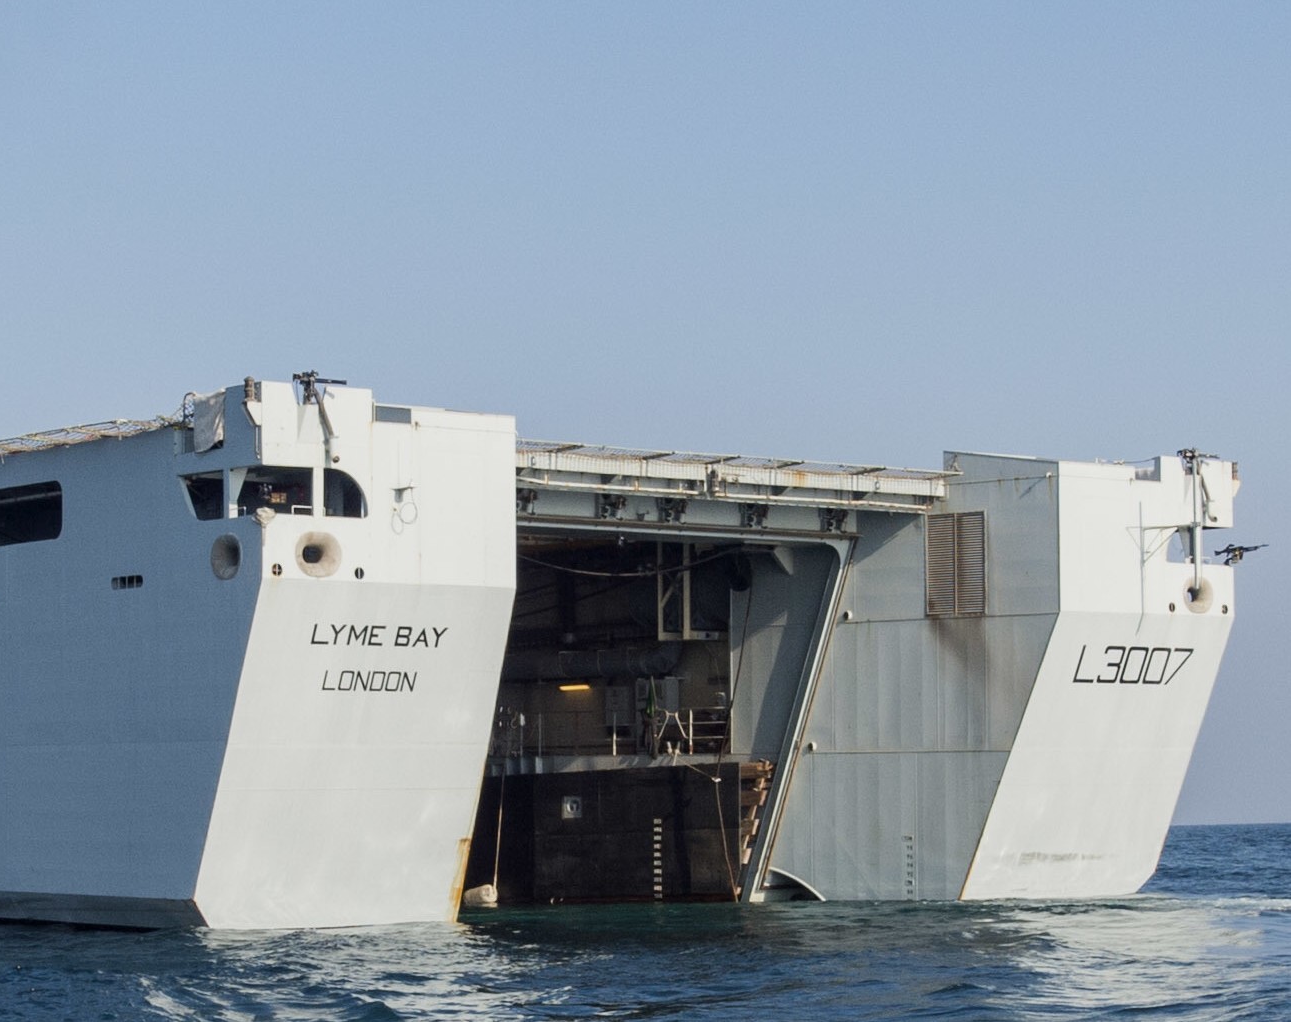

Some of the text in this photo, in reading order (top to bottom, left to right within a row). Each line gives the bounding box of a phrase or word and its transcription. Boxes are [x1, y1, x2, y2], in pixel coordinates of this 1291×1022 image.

[310, 623, 448, 648] LYME BAY
[1072, 644, 1194, 685] L3007
[322, 670, 417, 692] LONDON
